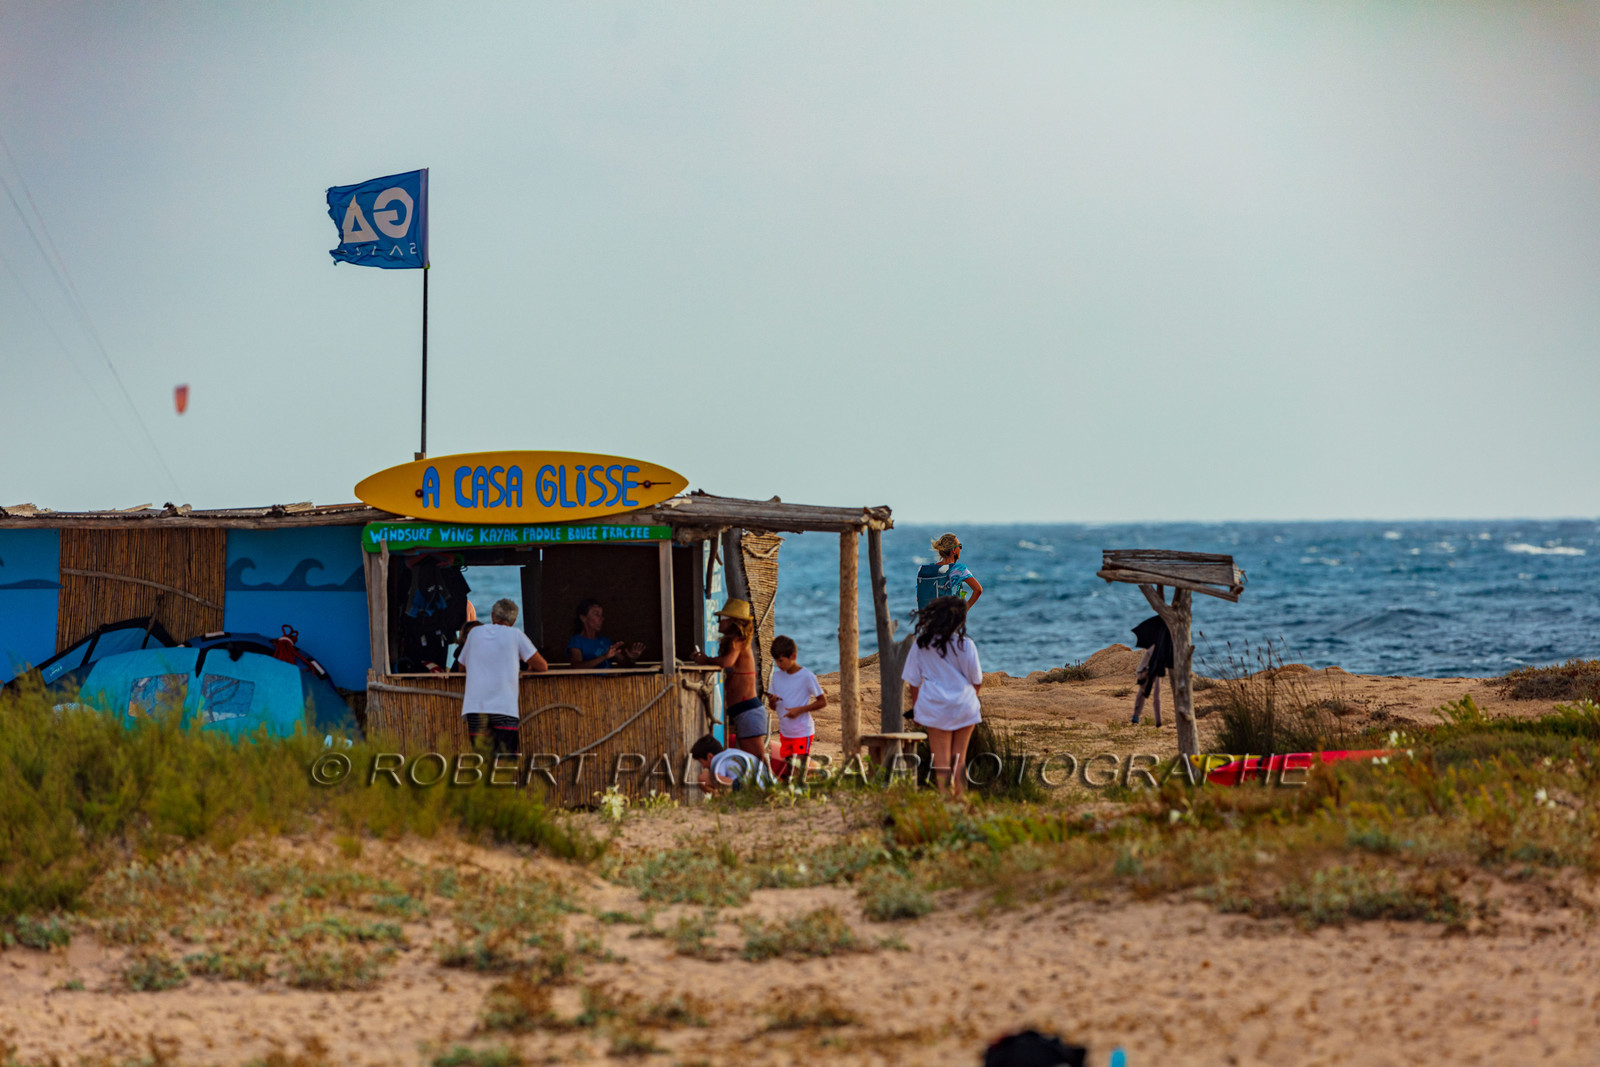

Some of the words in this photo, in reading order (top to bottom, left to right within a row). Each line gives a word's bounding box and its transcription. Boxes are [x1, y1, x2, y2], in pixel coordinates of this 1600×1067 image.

[422, 466, 440, 508] A
[454, 465, 523, 508] CASA
[479, 528, 519, 543] KAYAK
[522, 527, 561, 542] PADDLE
[567, 526, 598, 541] BOUEE
[602, 526, 650, 540] TRACTEE
